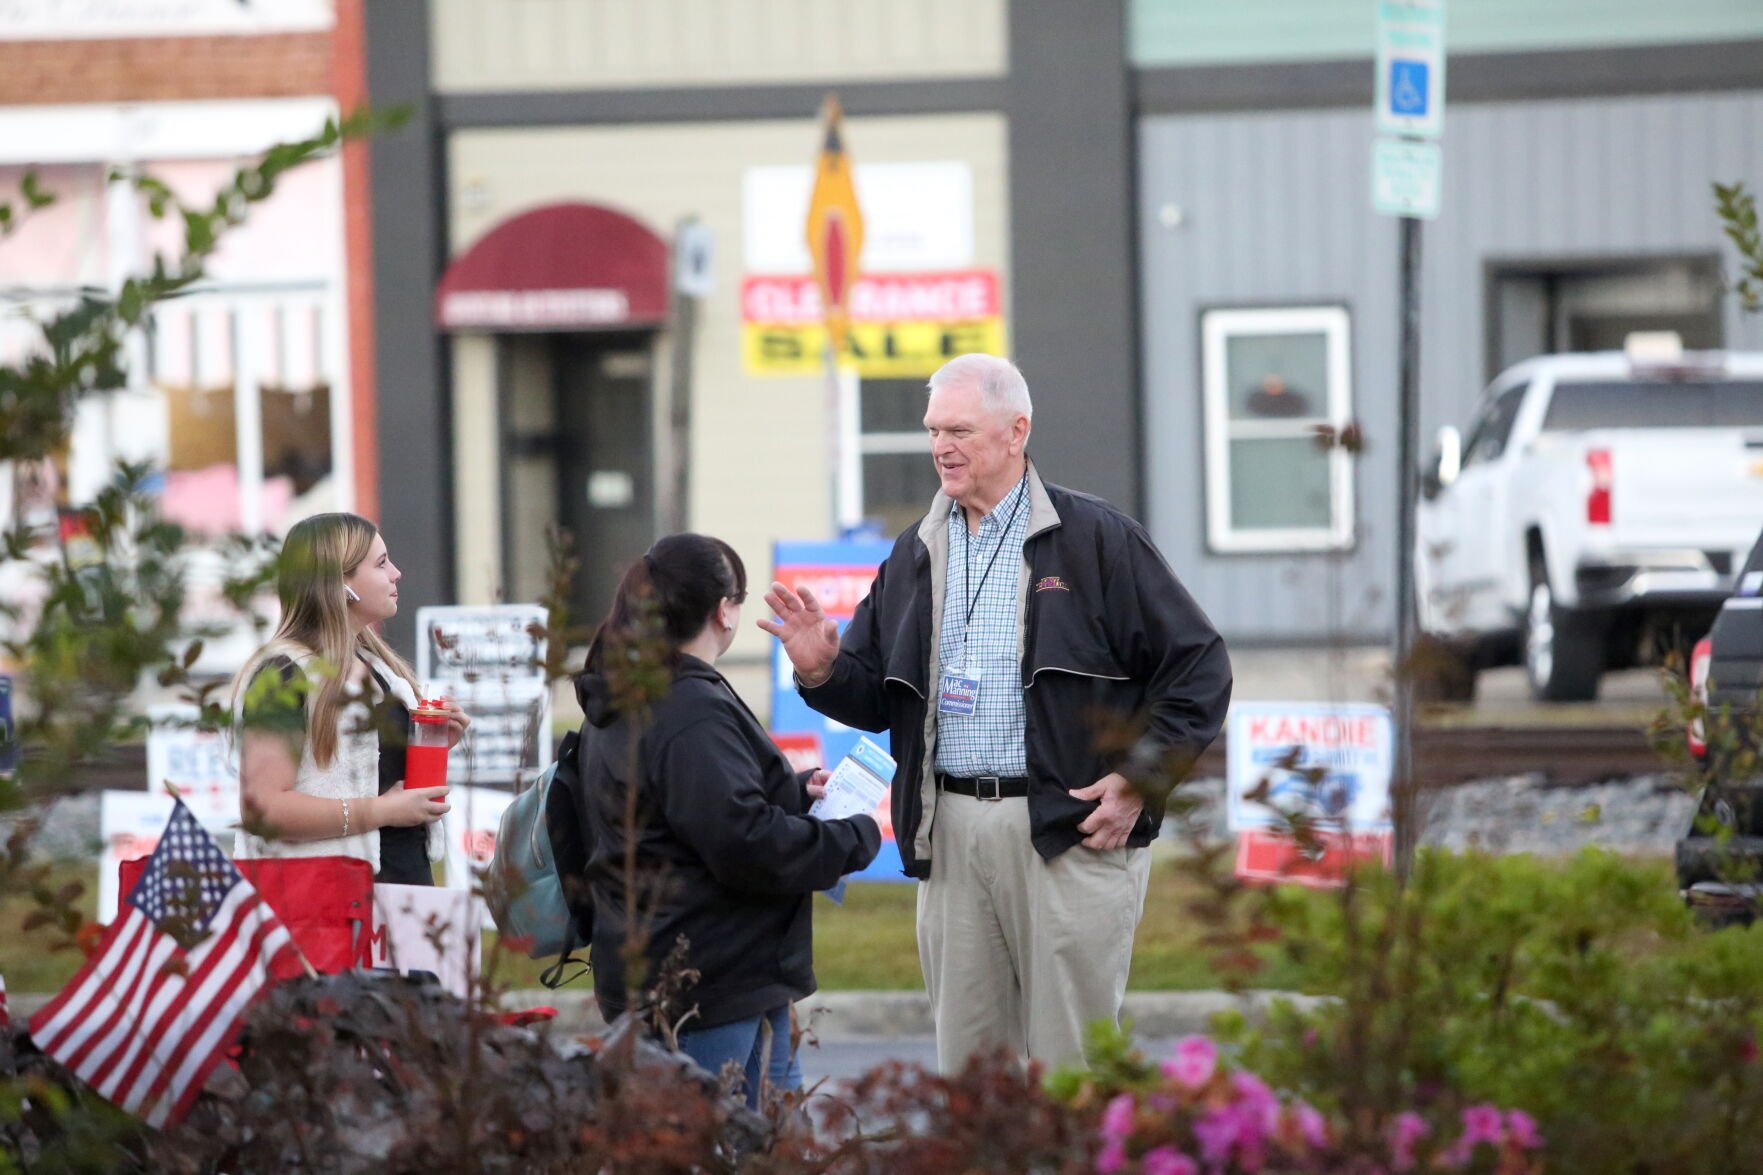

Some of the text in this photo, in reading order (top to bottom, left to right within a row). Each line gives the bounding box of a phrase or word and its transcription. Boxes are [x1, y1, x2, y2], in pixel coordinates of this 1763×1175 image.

[751, 279, 985, 319] CLERANCE
[943, 679, 976, 700] Manning
[1249, 714, 1378, 747] KANDIE
